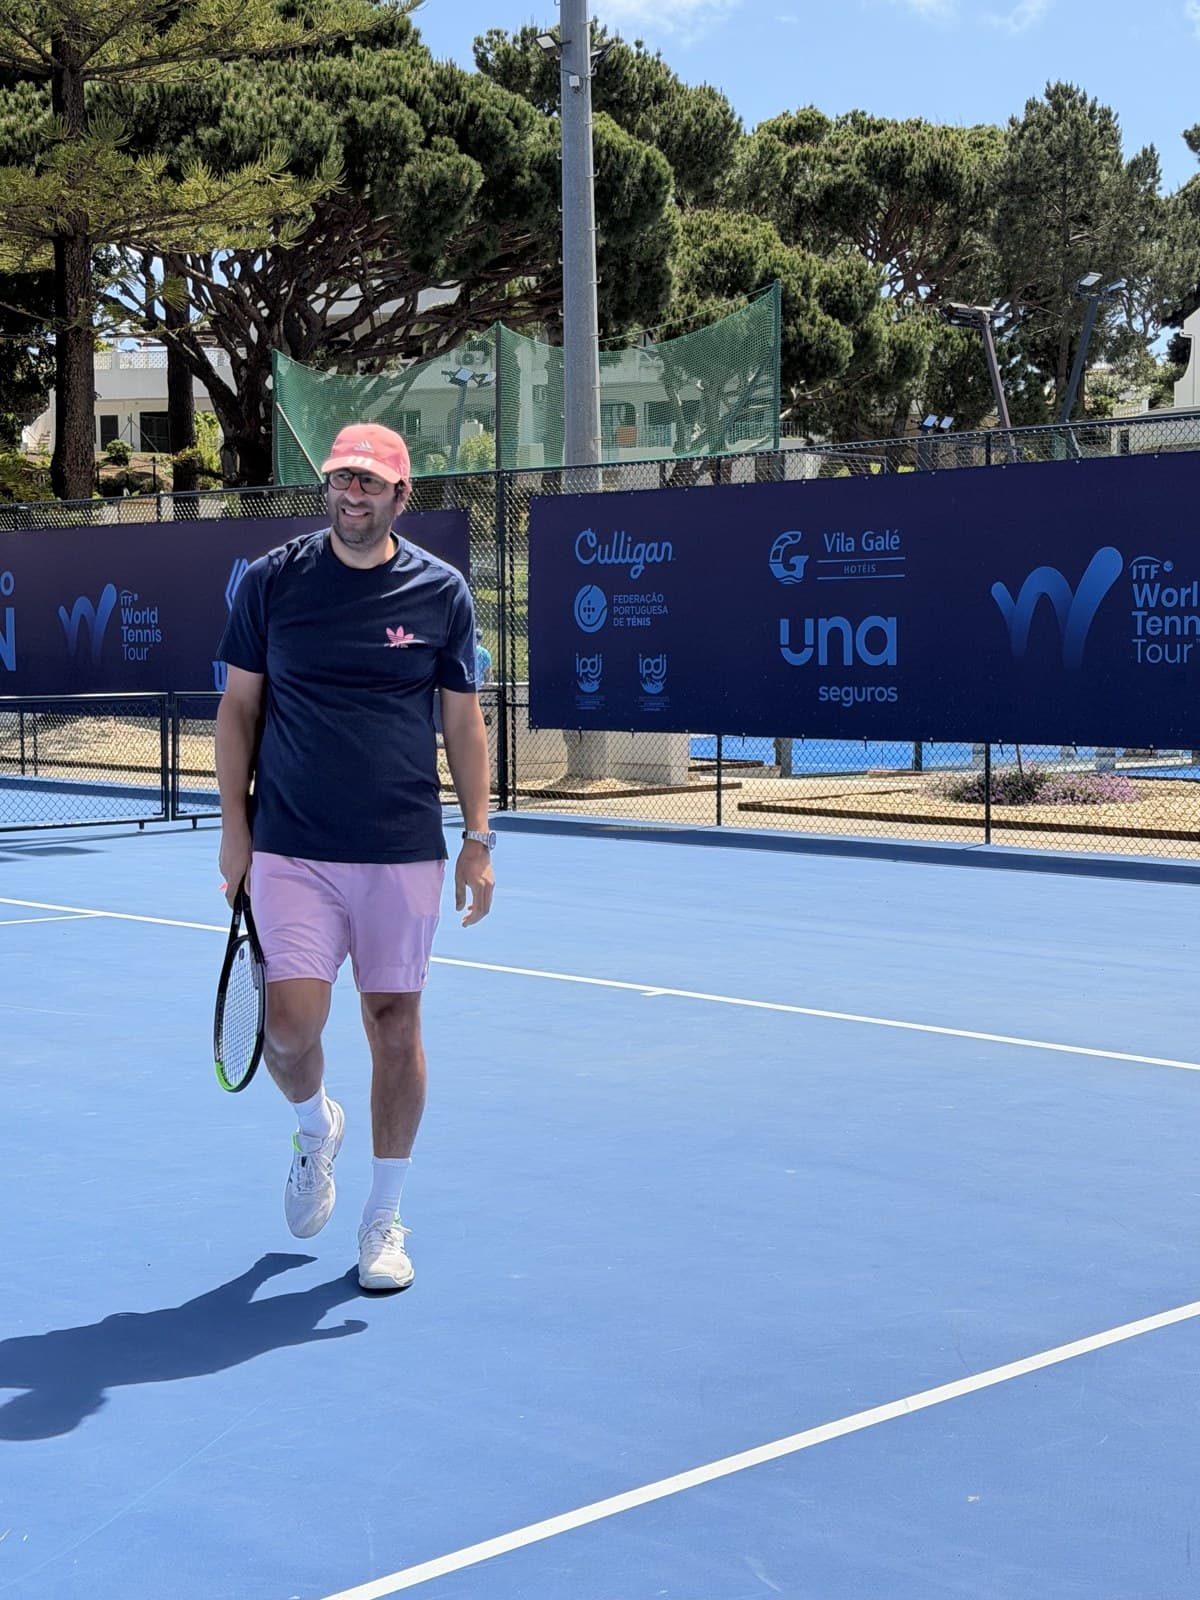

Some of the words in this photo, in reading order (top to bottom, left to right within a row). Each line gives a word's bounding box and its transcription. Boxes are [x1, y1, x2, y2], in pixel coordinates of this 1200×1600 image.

[824, 532, 855, 552] Vila
[861, 528, 900, 551] Galé
[575, 528, 673, 579] Culligan
[1132, 564, 1160, 580] ITF
[121, 596, 133, 606] ITF
[613, 592, 664, 604] FEDERAÇÃO
[121, 607, 158, 625] World
[613, 605, 669, 615] PORTUGUESA
[613, 617, 624, 627] DE
[626, 615, 651, 626] TÊNIS
[121, 625, 162, 643] Tennis
[780, 615, 897, 666] una
[121, 643, 149, 661] Tour
[1131, 638, 1193, 664] Tour
[818, 685, 898, 707] seguros
